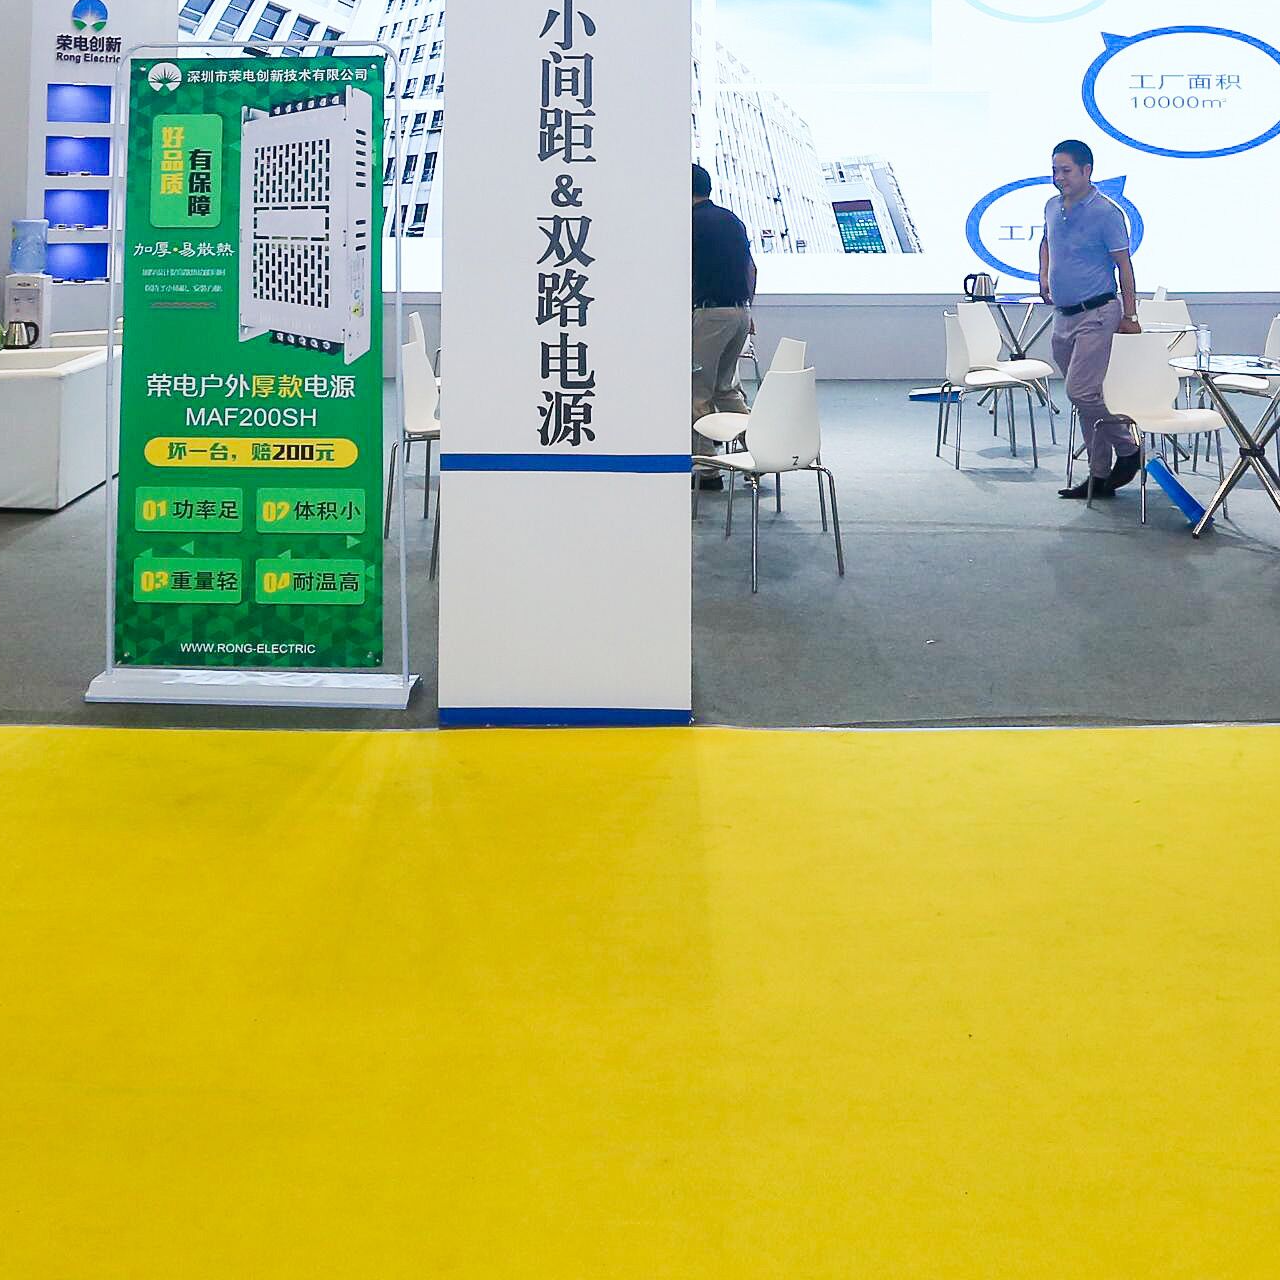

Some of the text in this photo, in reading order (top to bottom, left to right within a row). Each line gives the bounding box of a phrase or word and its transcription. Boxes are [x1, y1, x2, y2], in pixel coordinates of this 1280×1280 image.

[56, 35, 121, 52] 荣电创新
[56, 52, 81, 63] Rong
[187, 68, 368, 83] 深圳市荣电创新技术有限公司
[1129, 74, 1242, 90] 工厂面积
[160, 126, 185, 195] 好品质
[187, 149, 212, 216] 有保障
[146, 374, 356, 398] 荣电户外厚款电源
[186, 407, 317, 427] MAF200SH
[142, 500, 239, 520] 01 功率足
[262, 501, 361, 522] 02 体积小
[141, 571, 238, 592] 03 重量轻
[293, 572, 360, 592] 耐温高
[180, 642, 316, 654] WWW.RONG-ELECTRIC
